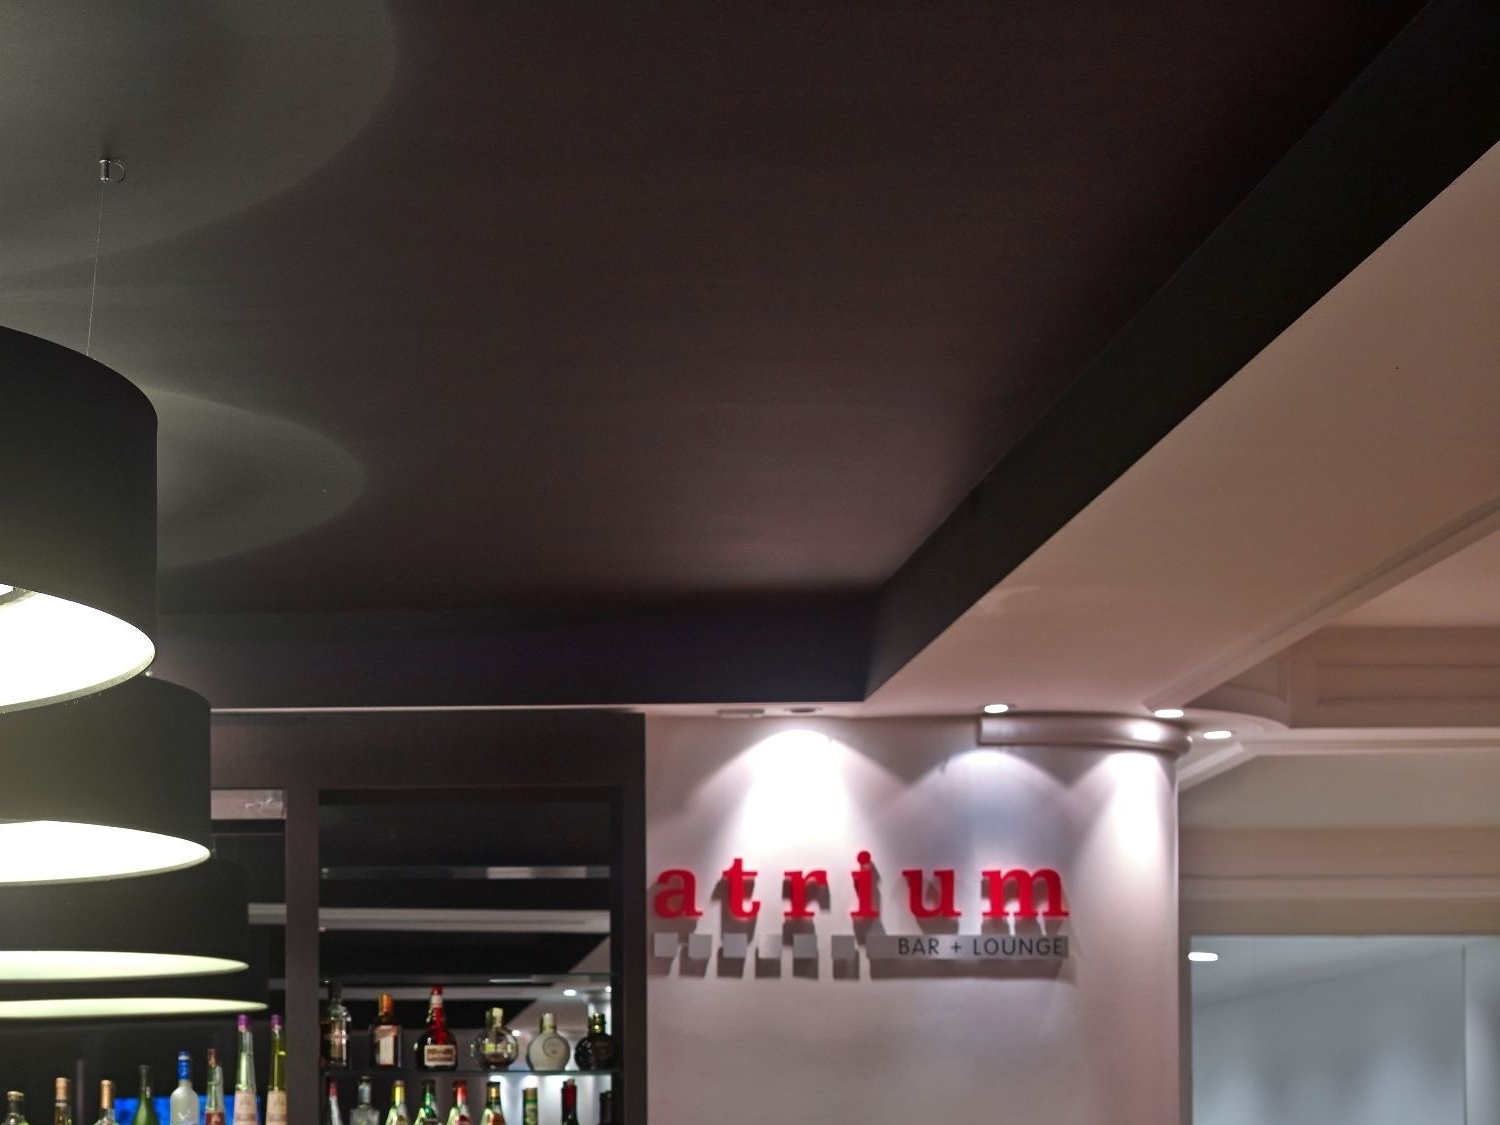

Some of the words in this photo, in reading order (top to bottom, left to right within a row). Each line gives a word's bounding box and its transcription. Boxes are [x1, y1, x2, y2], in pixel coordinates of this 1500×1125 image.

[652, 851, 1071, 919] atrium
[898, 937, 940, 955] BAR
[973, 936, 1063, 956] LOUNGE
